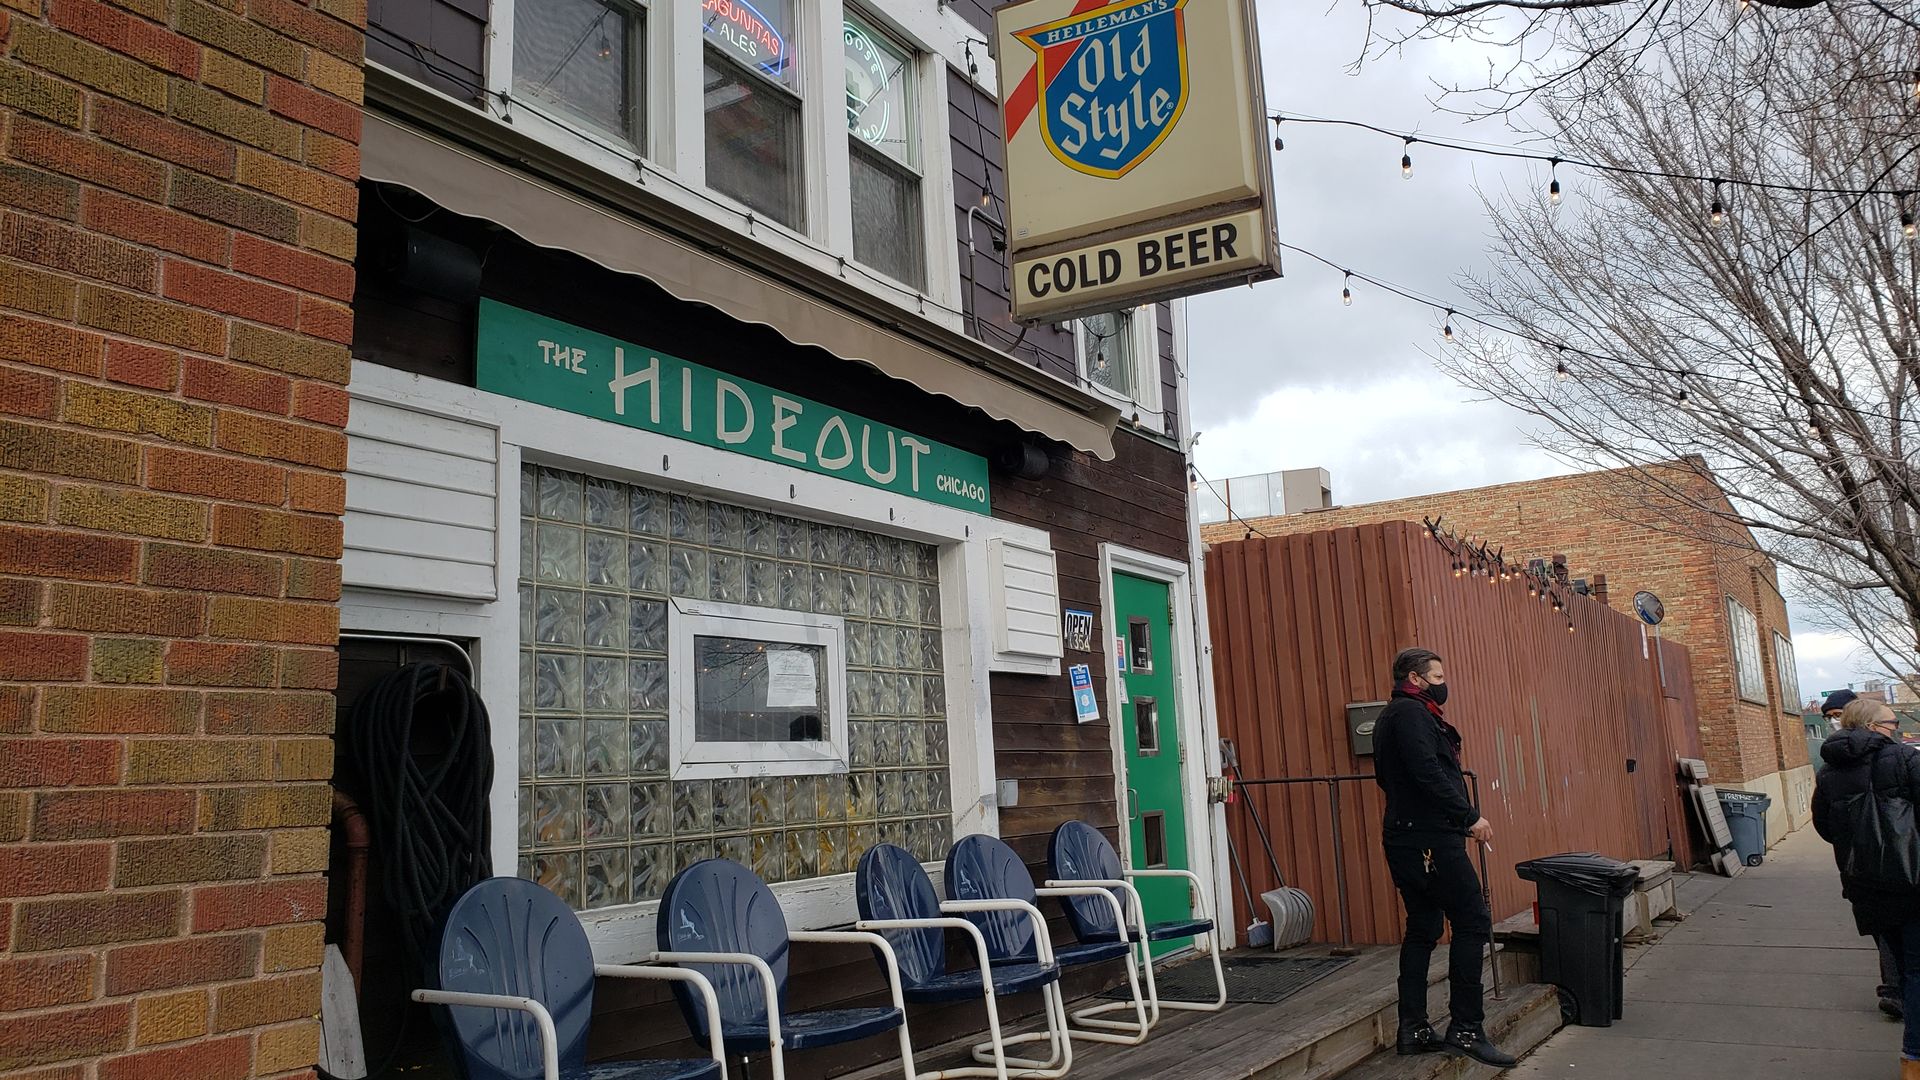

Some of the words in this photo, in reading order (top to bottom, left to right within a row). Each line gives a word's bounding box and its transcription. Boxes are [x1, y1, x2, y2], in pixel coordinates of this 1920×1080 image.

[720, 23, 756, 56] ALES
[1047, 0, 1168, 43] HEILEMAN'S
[845, 33, 878, 74] OOSE
[1078, 23, 1151, 92] Old
[1060, 80, 1170, 159] Style
[1028, 249, 1121, 298] COLD
[1137, 222, 1237, 277] BEER
[538, 340, 587, 374] THE
[608, 347, 930, 492] HIDEOUT
[936, 474, 985, 502] CHICAGO
[1066, 613, 1091, 635] OPEN
